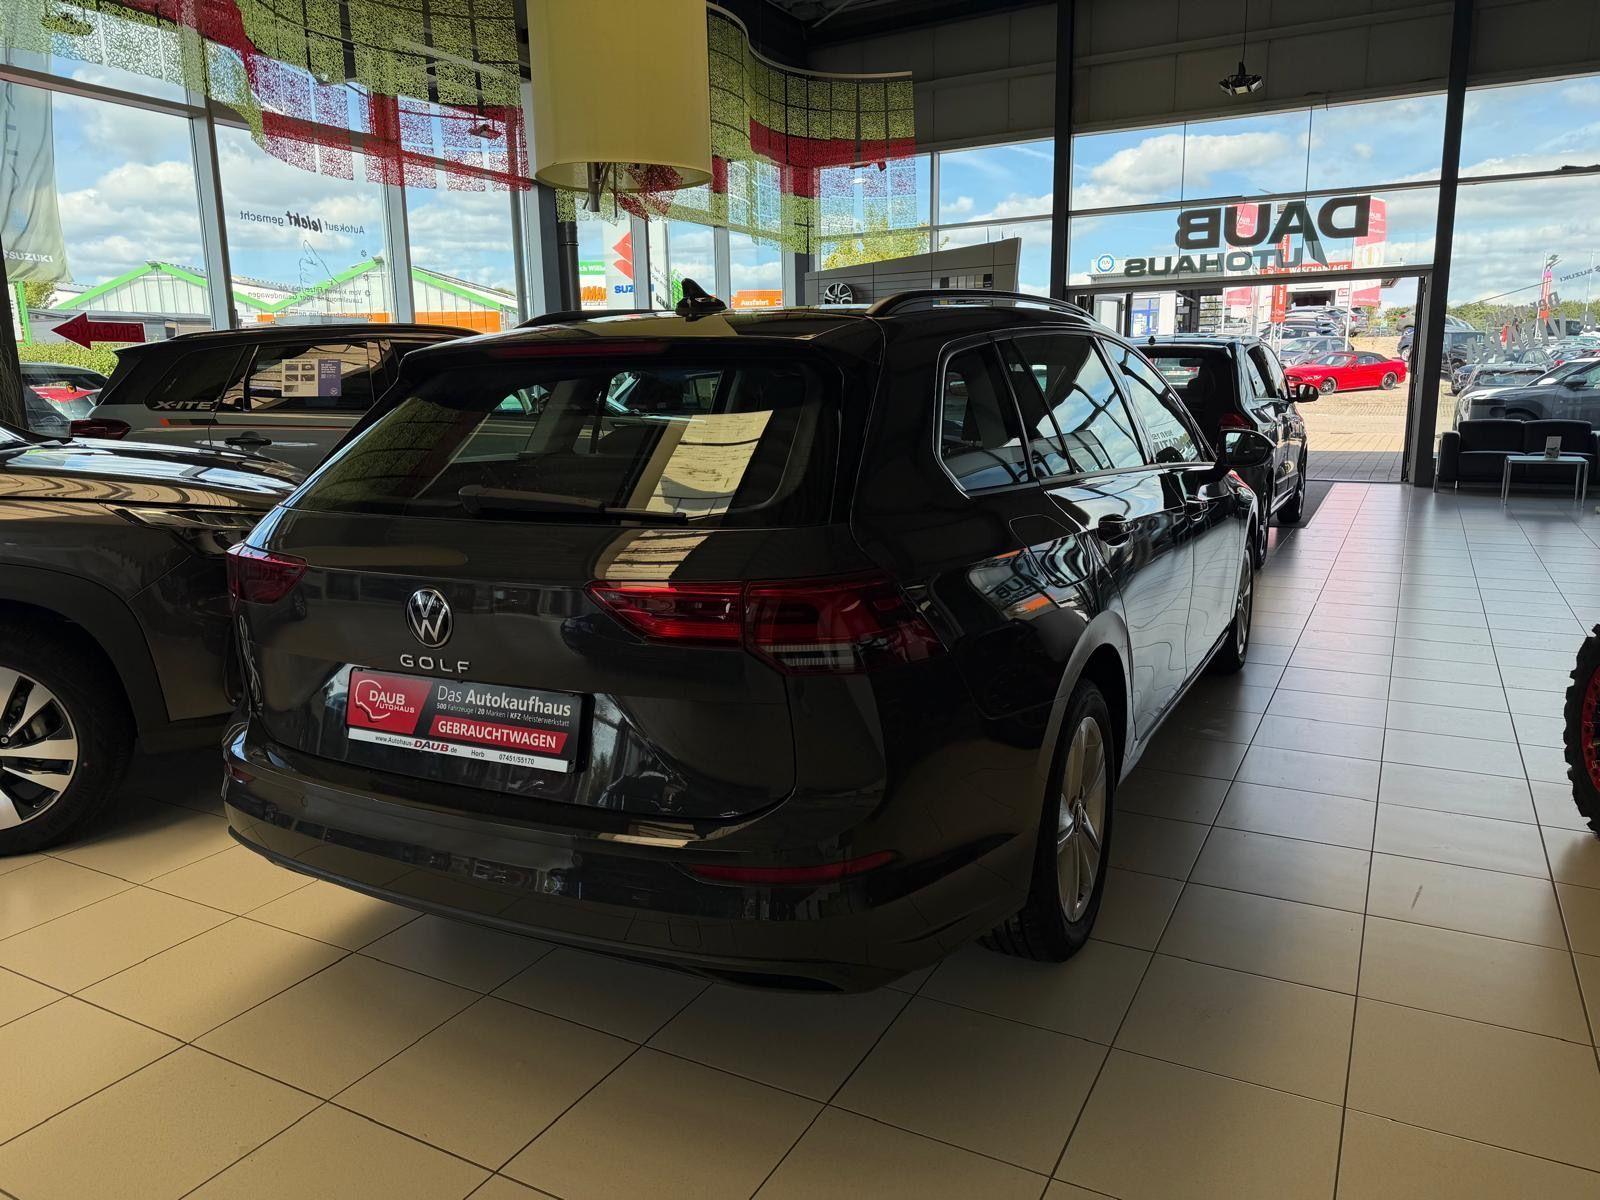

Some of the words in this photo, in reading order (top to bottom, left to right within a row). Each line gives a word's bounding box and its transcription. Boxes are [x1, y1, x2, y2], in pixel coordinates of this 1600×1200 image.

[9, 251, 54, 263] SUZUKI
[153, 401, 214, 410] X-ITE
[400, 654, 470, 674] GOLF
[369, 690, 405, 706] DAUB
[437, 685, 462, 702] Das
[465, 689, 571, 717] Autokaufhaus
[436, 702, 447, 710] 500
[448, 704, 474, 715] Fahrzeuge
[486, 708, 506, 718] Marken
[438, 720, 556, 748] GEBRAUCHTWAGEN
[471, 749, 485, 758] Horb
[498, 754, 535, 765] 07451/55170
